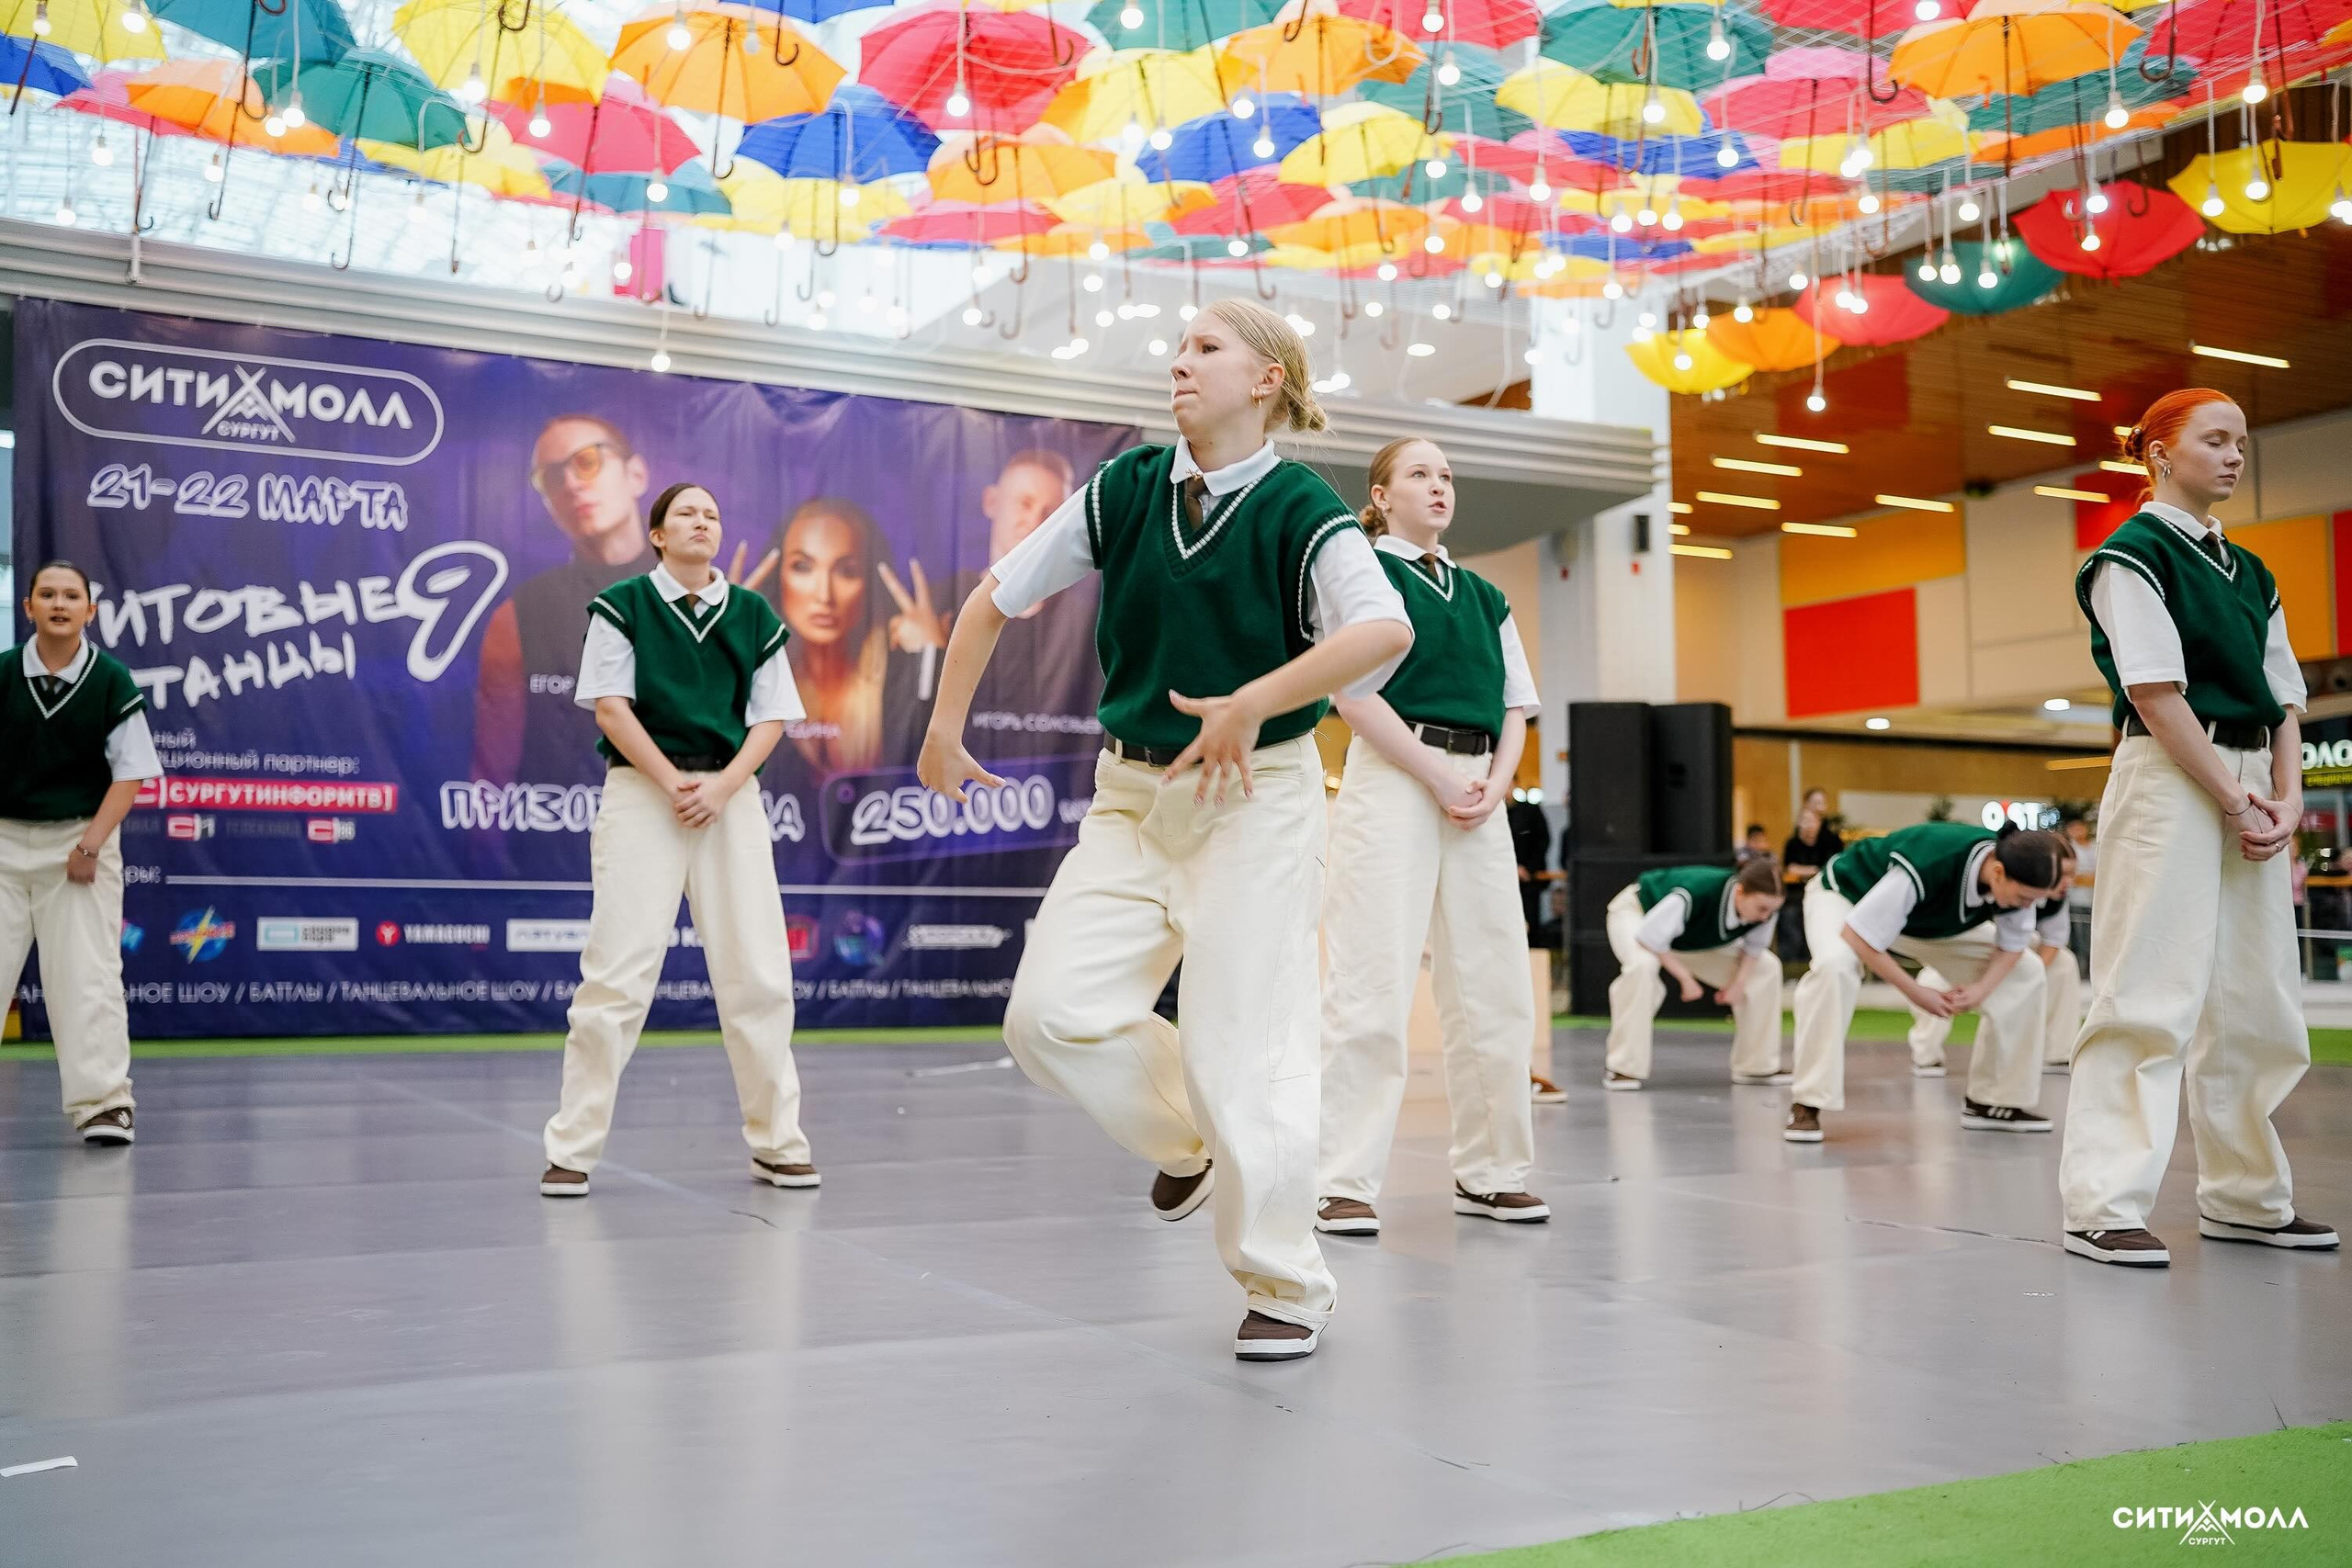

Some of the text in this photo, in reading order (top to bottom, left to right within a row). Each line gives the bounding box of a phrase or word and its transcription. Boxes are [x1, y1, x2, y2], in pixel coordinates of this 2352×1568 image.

[86, 463, 409, 532] 21-22 МАРТА
[89, 575, 400, 649] ИТОВЫЕ
[130, 630, 356, 710] ТАНЦЫ
[850, 773, 1055, 846] 250.000
[178, 980, 231, 1003] ШОУ
